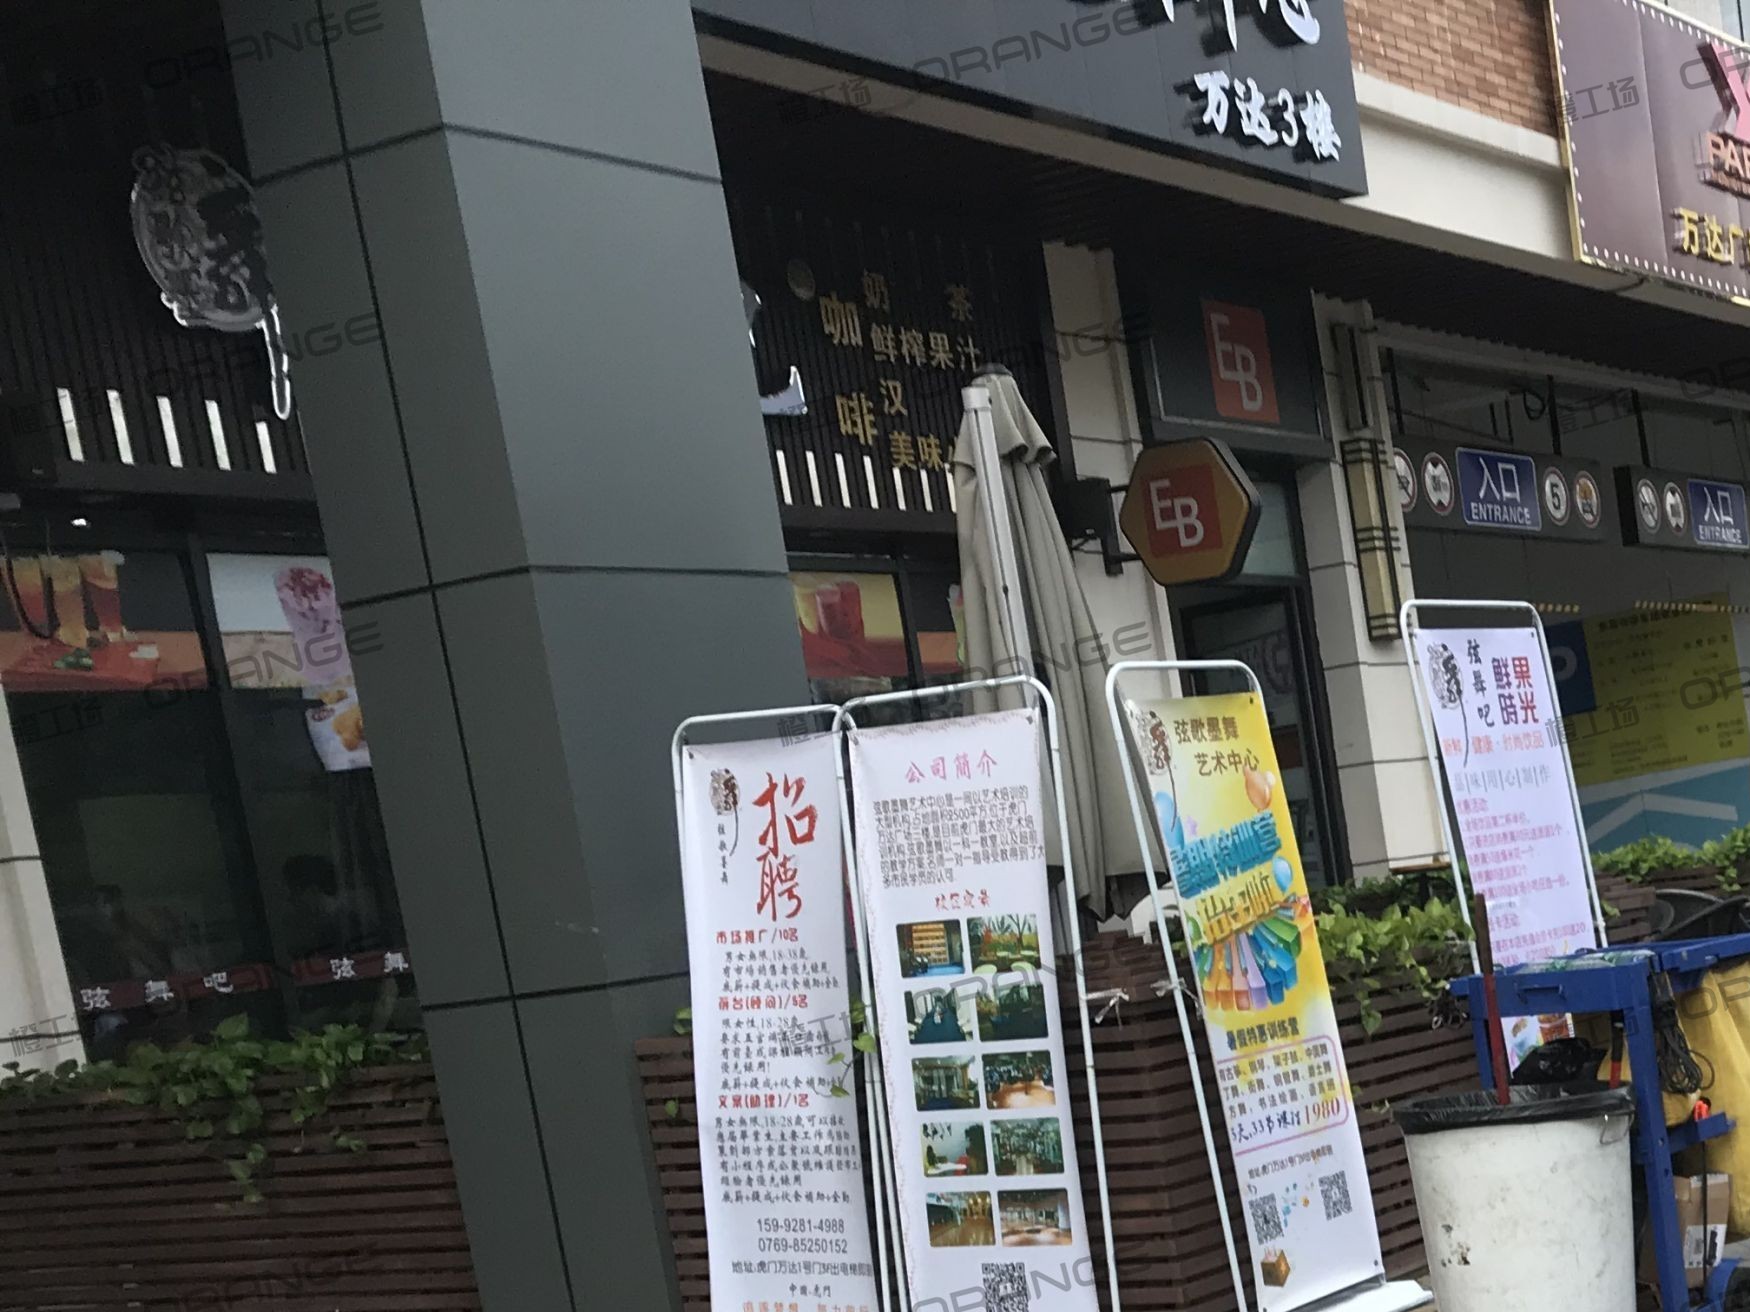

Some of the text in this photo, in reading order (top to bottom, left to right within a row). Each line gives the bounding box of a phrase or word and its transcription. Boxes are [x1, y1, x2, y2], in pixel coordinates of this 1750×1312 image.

[1194, 70, 1342, 161] 万达3楼
[870, 322, 981, 372] 鲜榨果汁
[1211, 313, 1263, 412] EB
[1479, 457, 1521, 503] 入口
[1551, 484, 1562, 511] 5
[1703, 487, 1734, 525] 入口
[1150, 479, 1204, 548] EB
[1470, 502, 1532, 525] ENTRANCE
[1698, 525, 1742, 544] ENTRANCE
[1174, 716, 1239, 744] 弦歌墨舞
[905, 749, 998, 783] 公司简介
[1194, 748, 1260, 777] 艺术中心
[752, 772, 818, 922] 招聘
[716, 927, 799, 944] 市场推广/10名
[81, 970, 235, 1013] 弦舞吧
[1305, 1098, 1340, 1125] 1980
[757, 1218, 845, 1234] 159-9281-4988
[758, 1237, 849, 1254] 0769-85250152
